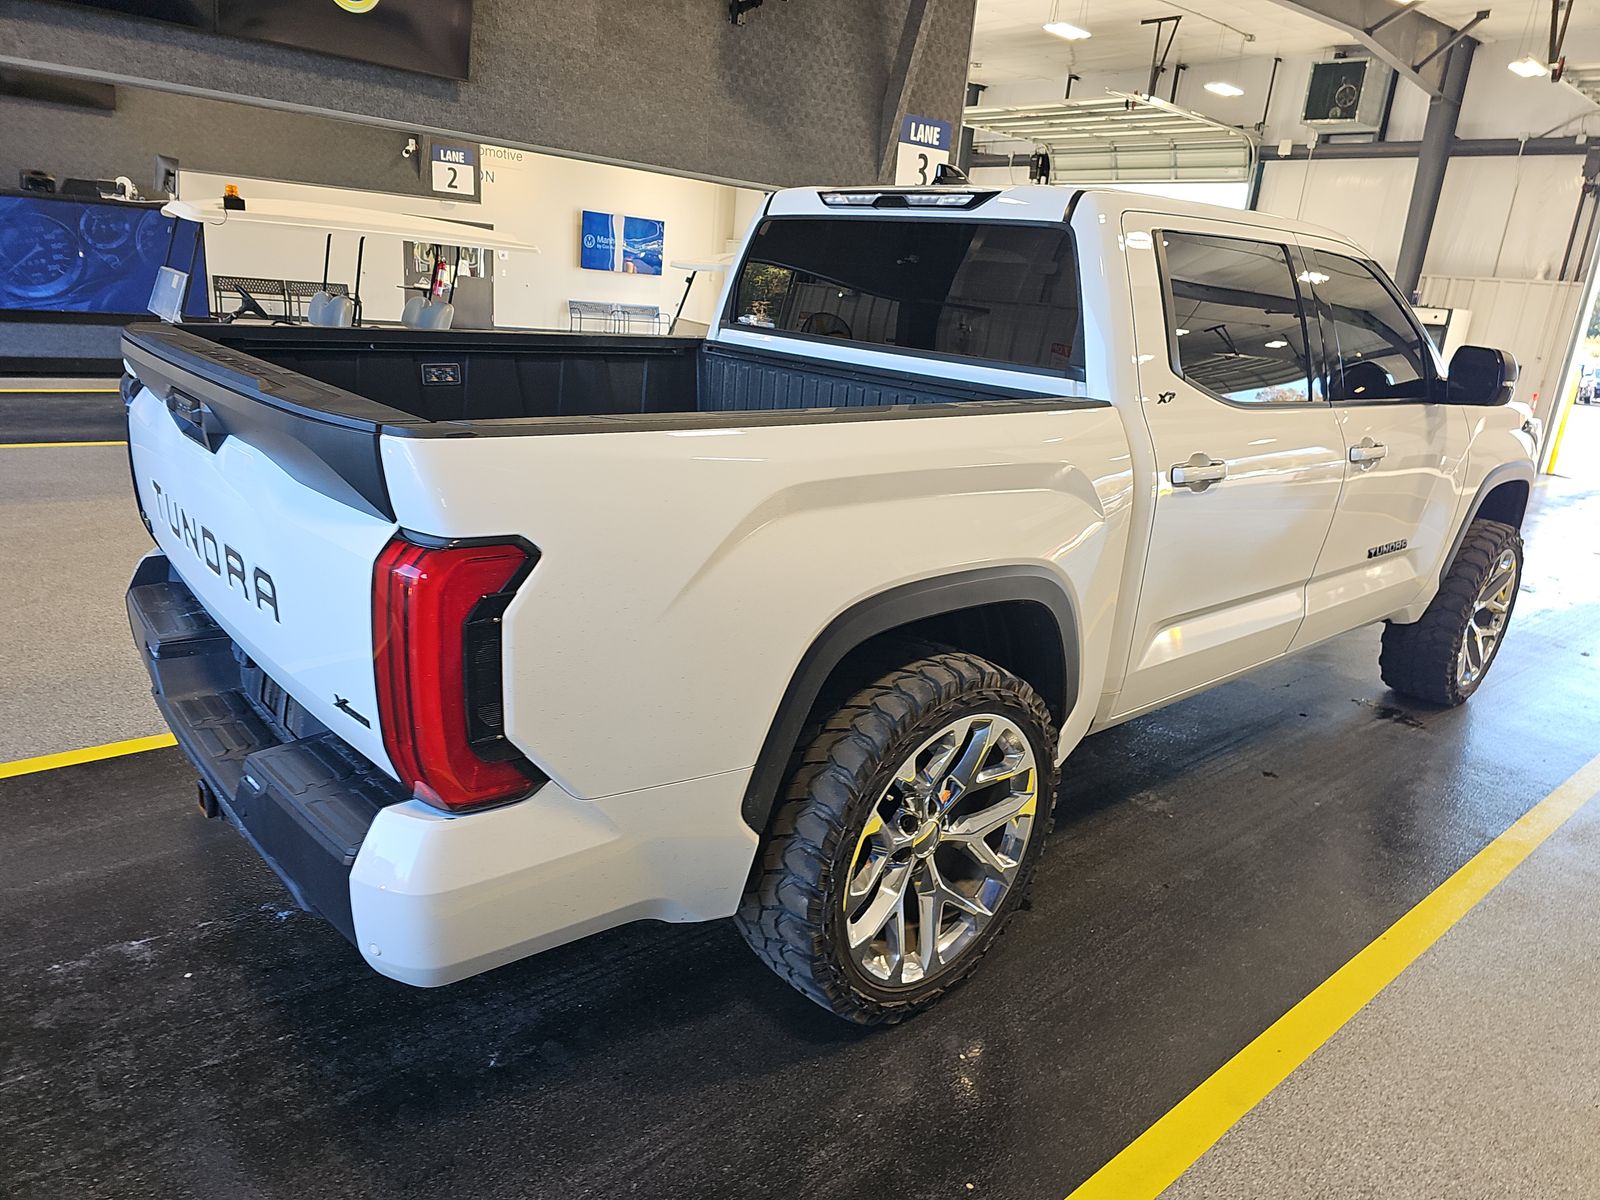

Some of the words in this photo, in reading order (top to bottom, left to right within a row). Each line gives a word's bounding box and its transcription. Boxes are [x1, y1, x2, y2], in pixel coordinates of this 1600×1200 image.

[910, 121, 941, 146] LANE
[440, 149, 465, 163] LANE
[447, 167, 458, 189] 2
[914, 153, 929, 185] 3
[152, 479, 281, 624] TUNDRA
[1367, 539, 1408, 559] TUNDRA
